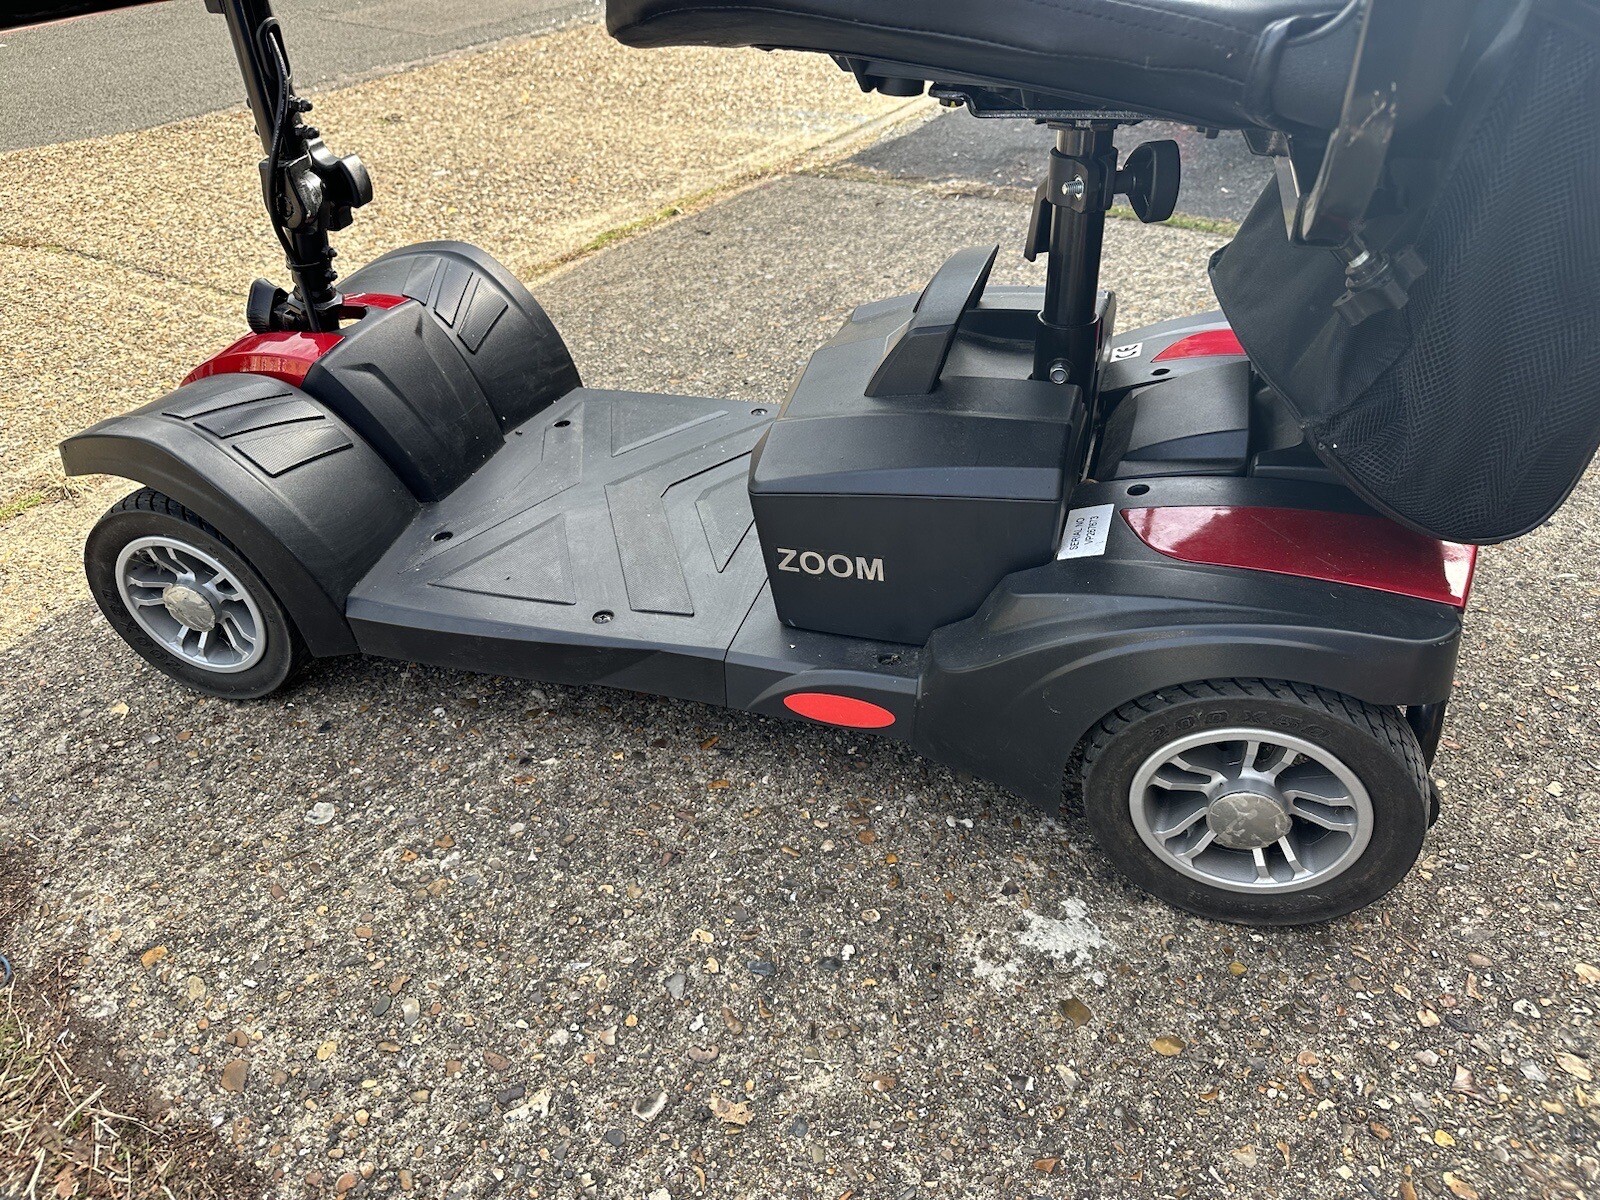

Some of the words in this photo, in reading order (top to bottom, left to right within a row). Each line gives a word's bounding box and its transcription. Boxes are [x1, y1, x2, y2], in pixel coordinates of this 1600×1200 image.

[1115, 344, 1138, 358] CE
[1075, 517, 1085, 528] NO
[1069, 528, 1083, 551] SERIAL
[776, 547, 886, 582] ZOOM
